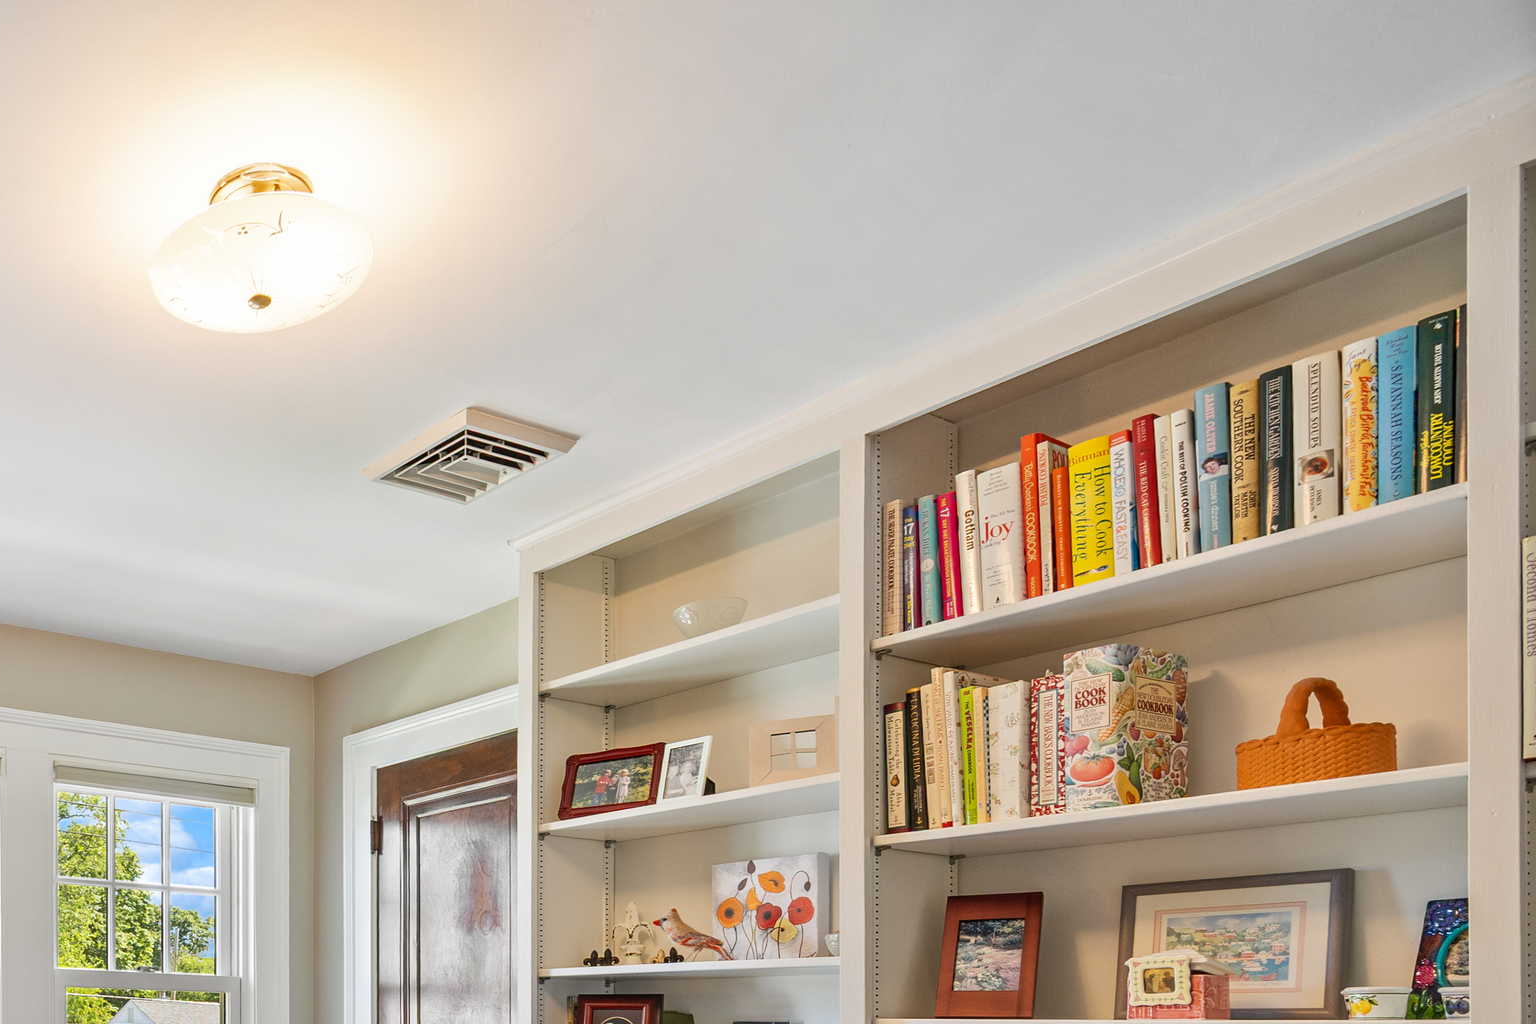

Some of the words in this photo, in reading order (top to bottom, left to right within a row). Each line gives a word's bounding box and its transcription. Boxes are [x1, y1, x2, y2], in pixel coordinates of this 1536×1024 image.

[1310, 363, 1319, 413] SPLENDID
[1434, 366, 1442, 388] MARTIN
[1204, 393, 1215, 421] JAMIE
[1268, 392, 1281, 424] KITCHEN
[1390, 365, 1403, 429] SAVANNAH
[1434, 389, 1442, 404] JOHN
[1206, 422, 1216, 454] OLIVER
[1233, 398, 1243, 454] SOUTHERN
[1245, 414, 1255, 433] THE
[1311, 417, 1319, 448] SOUPS
[1068, 448, 1110, 467] Bittman
[1245, 434, 1255, 461] NEW
[1269, 424, 1281, 460] GARDEN
[1390, 430, 1403, 481] SEASONS
[1430, 412, 1443, 481] LOWCOUNTRY
[1442, 420, 1454, 466] COOKING
[1039, 449, 1049, 480] COOKING
[1234, 455, 1243, 483] COOK
[1039, 482, 1049, 507] POLISH
[1094, 464, 1111, 497] How
[1209, 480, 1218, 504] jamie's
[1071, 471, 1094, 563] Everything
[1095, 501, 1107, 516] to
[904, 524, 914, 535] 17
[964, 510, 975, 551] Gotham
[1095, 519, 1113, 557] Cook
[1043, 694, 1053, 708] THE
[1074, 695, 1107, 709] BOOK
[1075, 686, 1107, 700] COOK
[1150, 687, 1159, 695] THE
[1044, 709, 1053, 725] NEW
[1137, 699, 1174, 715] COOKBOOK
[886, 716, 894, 756] Midwestern
[894, 718, 902, 757] Celebrating
[910, 712, 919, 744] CUCINA
[965, 710, 973, 750] VESELKA
[1044, 726, 1053, 749] BASICS
[913, 758, 921, 780] LIDIA
[1044, 749, 1054, 787] COOKBOOK
